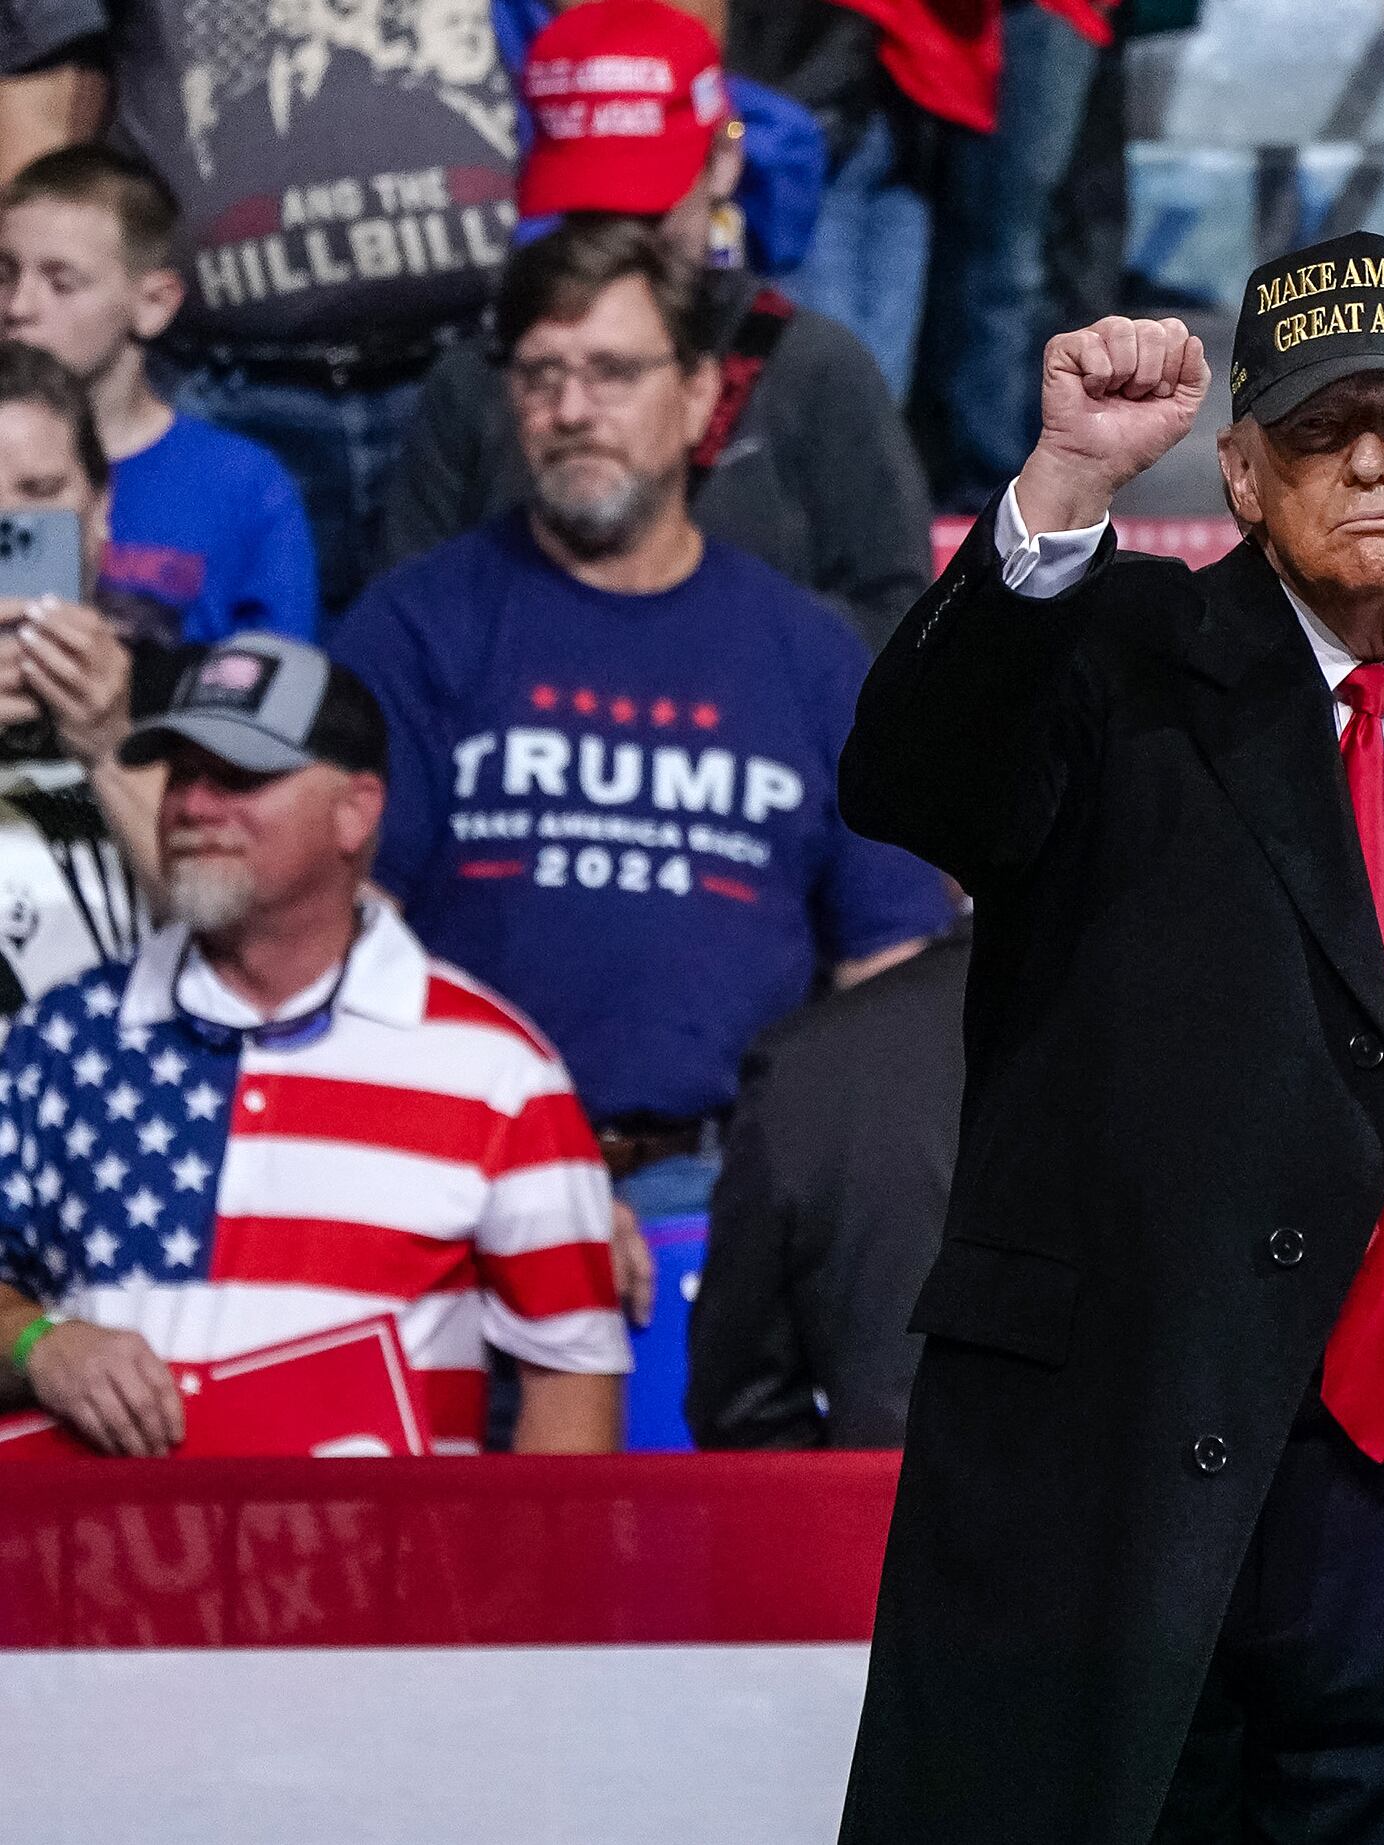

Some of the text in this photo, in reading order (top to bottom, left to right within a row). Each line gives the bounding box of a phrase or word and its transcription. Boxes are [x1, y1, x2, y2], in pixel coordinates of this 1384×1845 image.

[1257, 262, 1337, 315] MAKE
[1274, 303, 1365, 352] GREAT
[453, 727, 804, 823] TRUMP
[534, 846, 692, 895] 2024
